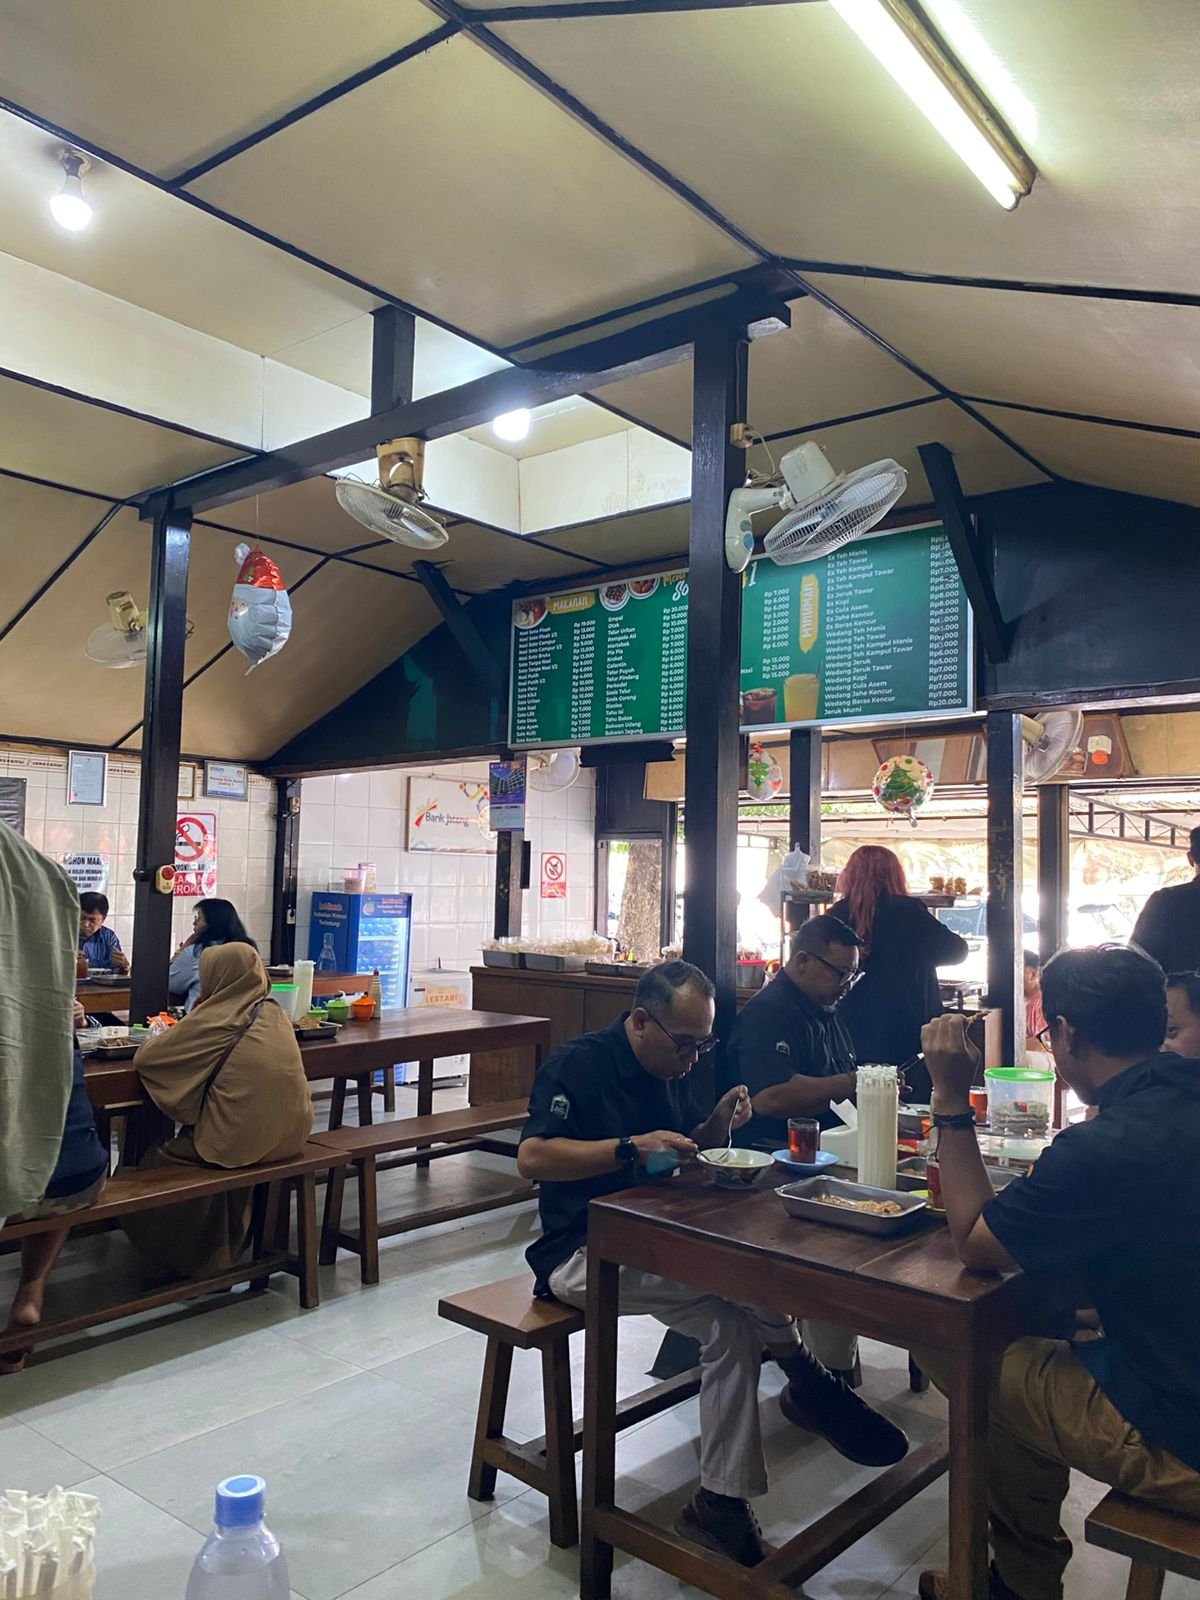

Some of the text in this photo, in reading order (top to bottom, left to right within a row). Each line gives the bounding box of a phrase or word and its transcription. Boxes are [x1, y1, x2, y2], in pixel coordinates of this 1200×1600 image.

[849, 549, 868, 557] Manis
[849, 557, 868, 565] Tawar
[849, 563, 873, 573] Kampul
[931, 566, 958, 575] Rp7.000
[848, 571, 873, 580] Kampul
[874, 568, 894, 576] Tawar
[835, 582, 853, 590] Jeruk
[773, 588, 790, 596] 7.000
[835, 606, 849, 614] Gula
[851, 611, 874, 619] Kencur
[834, 621, 852, 629] Beras
[826, 629, 852, 638] Wedang
[866, 624, 886, 632] Manis
[826, 637, 852, 645] Wedang
[866, 633, 886, 641] Tawar
[825, 645, 852, 653] Wedang
[866, 640, 891, 649] Kampul
[825, 653, 852, 661] Wedang
[866, 648, 891, 656] Kampul
[929, 648, 958, 657] Rp6.000
[825, 658, 871, 669] Wedang Jeruk
[929, 656, 958, 665] Rp5.000
[853, 666, 870, 674] Jeruk
[929, 665, 957, 674] Rp7.000
[825, 674, 867, 684] Wedang Kopi
[929, 673, 957, 682] Rp7.000
[824, 684, 851, 692] Wedang
[929, 681, 957, 690] Rp7.000
[824, 691, 851, 700] Wedang
[929, 690, 957, 698] Rp7.000
[824, 699, 851, 707] Wedang
[929, 698, 961, 707] Rp20.000
[824, 707, 842, 715] Jeruk
[425, 812, 444, 823] Bank
[68, 857, 101, 865] OHON MAA
[426, 994, 458, 1003] LESTARI
